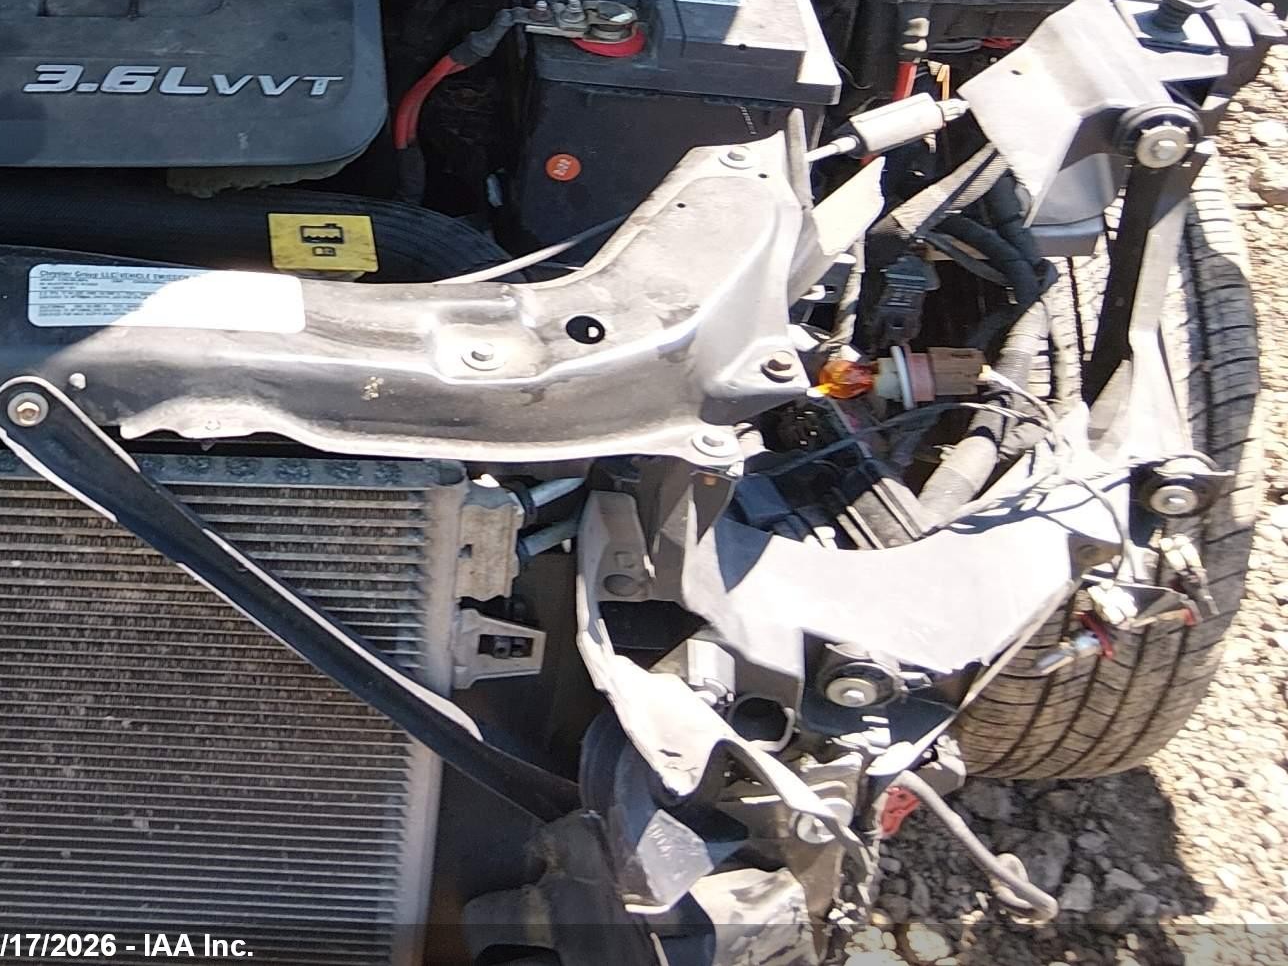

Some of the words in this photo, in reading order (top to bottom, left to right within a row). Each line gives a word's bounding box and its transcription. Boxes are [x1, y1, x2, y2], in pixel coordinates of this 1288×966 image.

[23, 63, 209, 95] 3.6L
[211, 73, 344, 96] VVT
[39, 270, 72, 279] Chrysler
[75, 270, 97, 280] Group
[100, 272, 116, 280] LLC
[120, 273, 150, 281] VEHICLE
